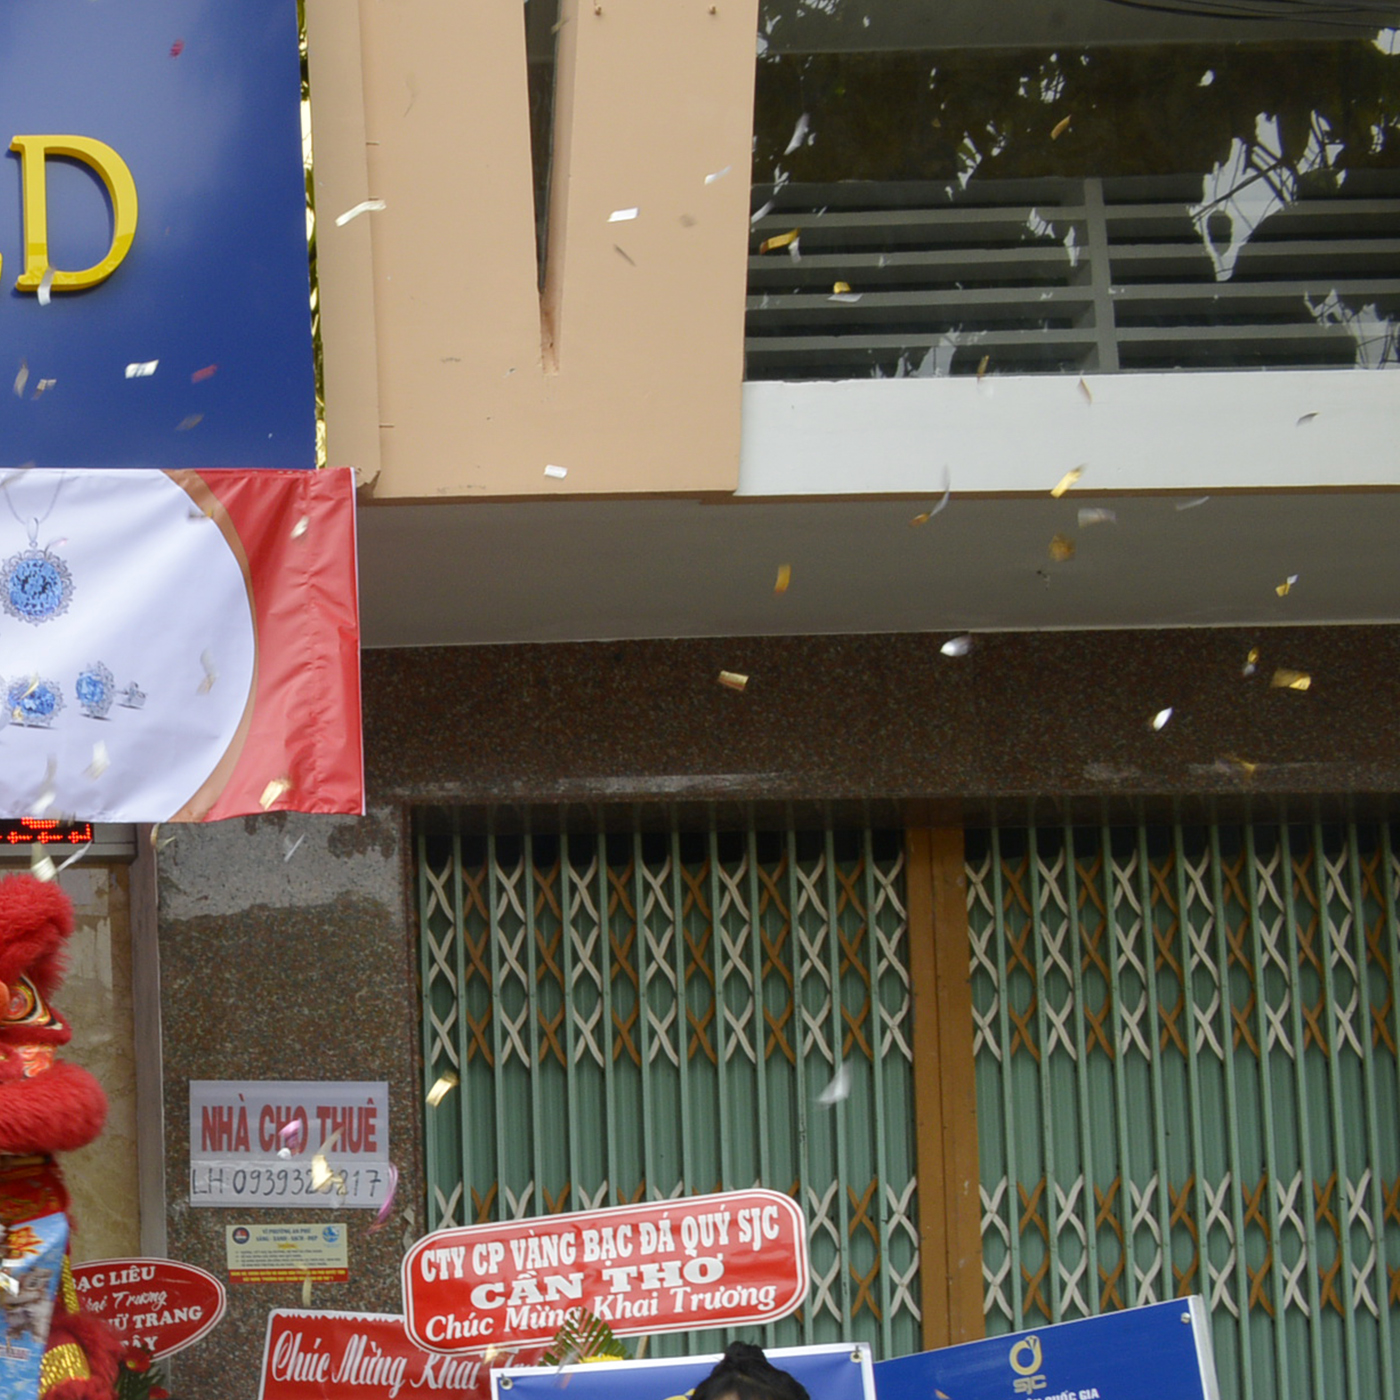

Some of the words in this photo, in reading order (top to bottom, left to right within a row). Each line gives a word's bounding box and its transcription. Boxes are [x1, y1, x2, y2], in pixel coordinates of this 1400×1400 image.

[202, 1093, 251, 1152] NHÀ
[259, 1104, 309, 1154] CHO
[316, 1097, 378, 1152] THUÊ
[420, 1246, 466, 1283] CTY
[472, 1242, 505, 1276] CP
[509, 1229, 577, 1273] VÀNG
[582, 1222, 633, 1266] BẠC
[639, 1211, 676, 1256] ĐÁ
[681, 1202, 731, 1257] QUÝ
[738, 1204, 780, 1252] SJC
[109, 1264, 157, 1288] LIÊU
[470, 1270, 585, 1310] CẦN
[602, 1252, 725, 1293] THƠ
[132, 1304, 204, 1329] TRANG
[425, 1309, 495, 1343] Chúc
[594, 1292, 659, 1321] Khai
[670, 1282, 777, 1313] Trương
[271, 1330, 331, 1383] Chúc
[331, 1333, 409, 1399] Mừng
[1013, 1374, 1048, 1395] SJC
